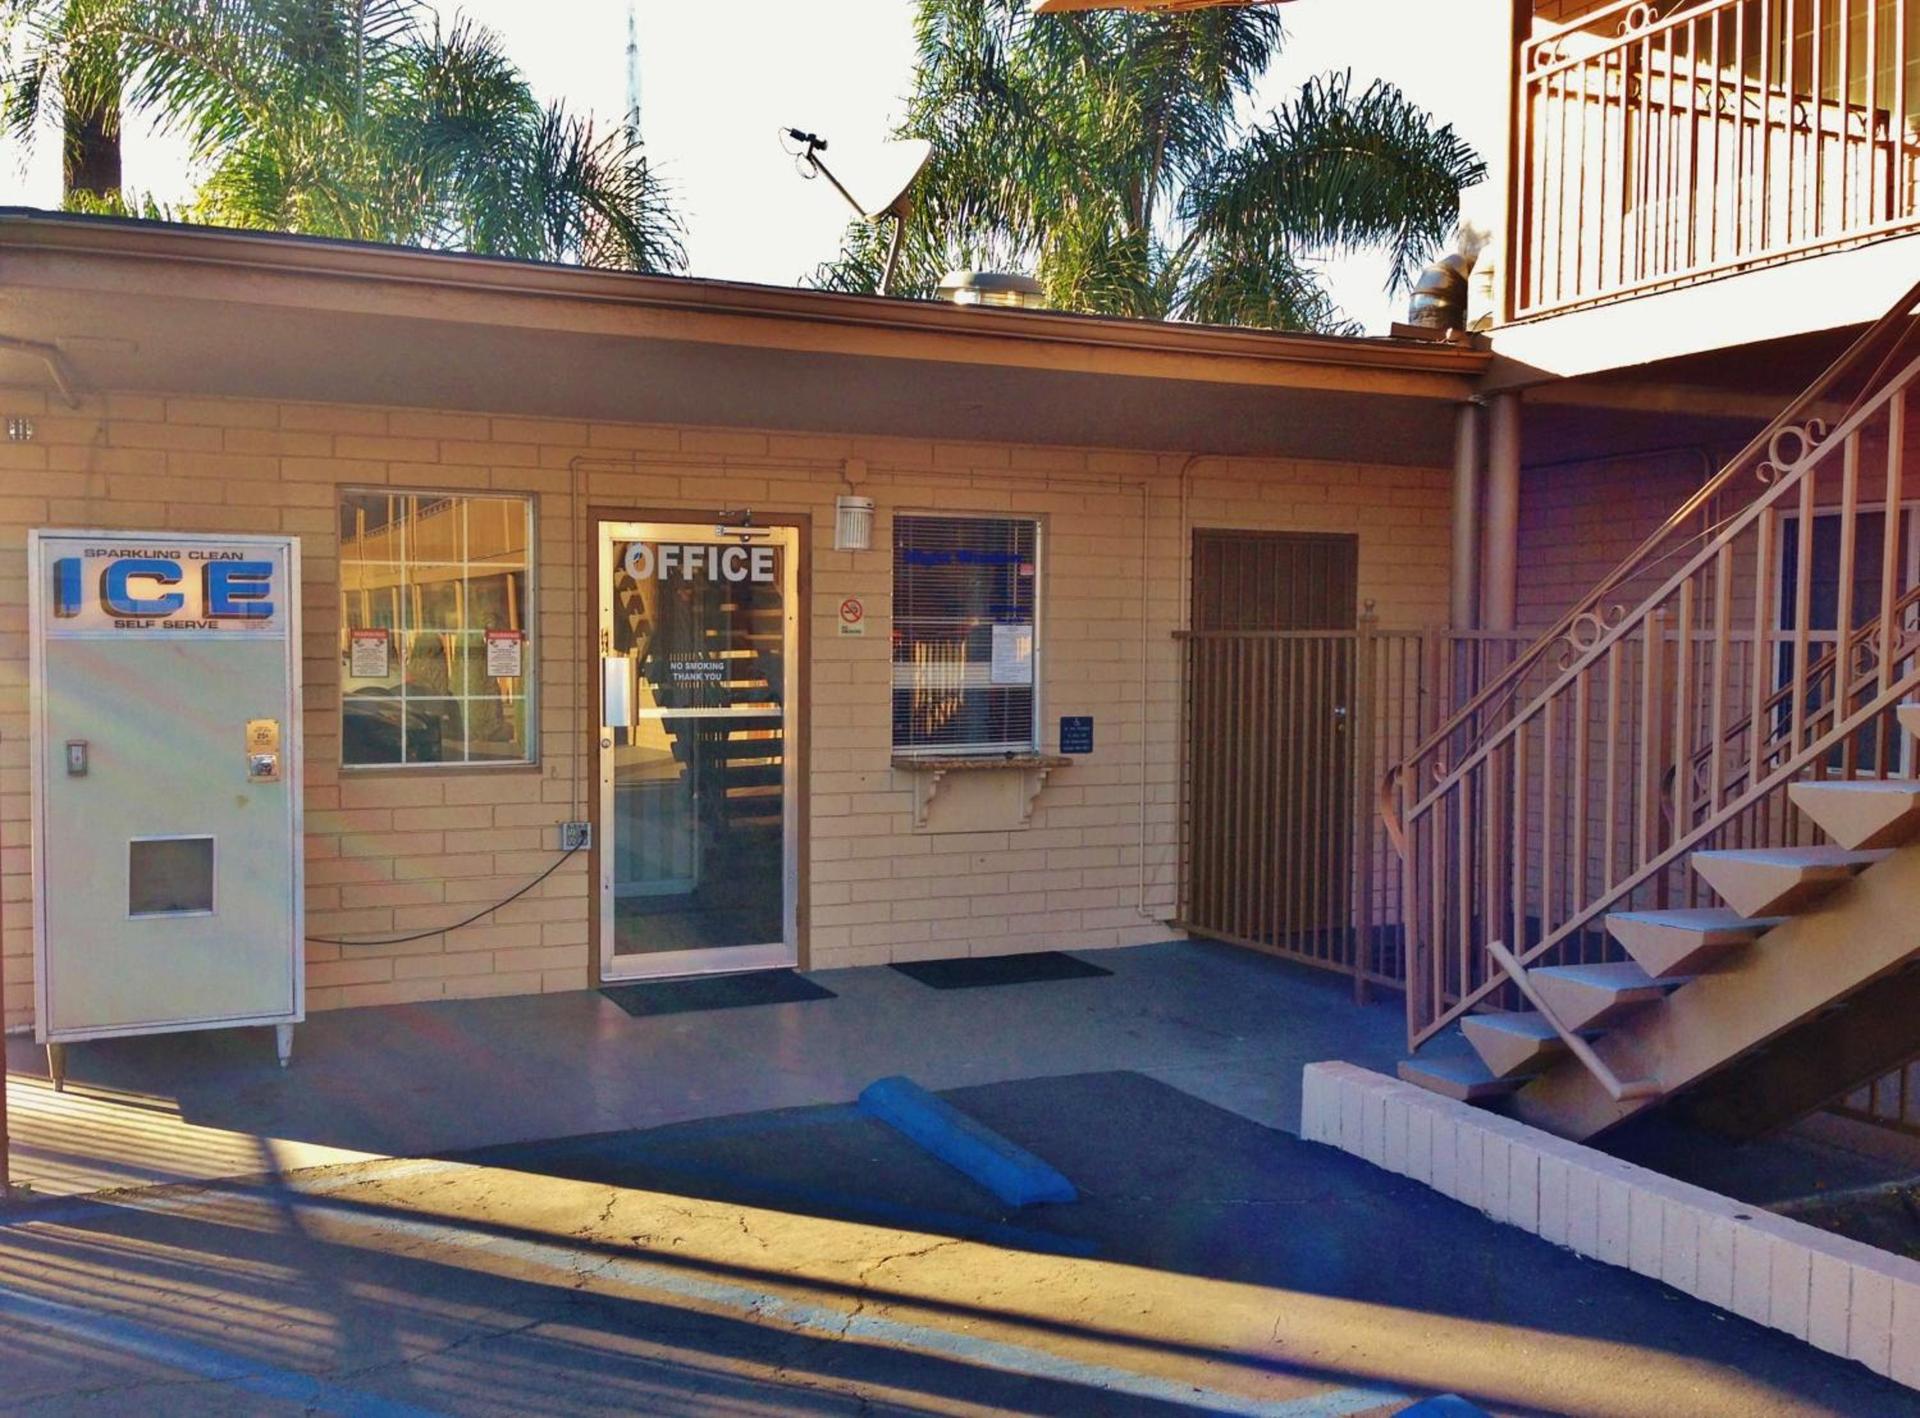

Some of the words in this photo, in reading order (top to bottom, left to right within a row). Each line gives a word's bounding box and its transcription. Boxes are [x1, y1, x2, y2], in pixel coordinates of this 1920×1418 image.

[84, 548, 181, 560] SPARKLING
[188, 550, 244, 561] CLEAN
[624, 542, 775, 582] OFFICE
[53, 557, 273, 619] ICE
[114, 619, 156, 629] SELF
[162, 619, 219, 630] SERVE
[670, 662, 683, 670] NO
[685, 662, 725, 671] SMOKING
[673, 672, 702, 681] THANK
[704, 672, 722, 681] YOU
